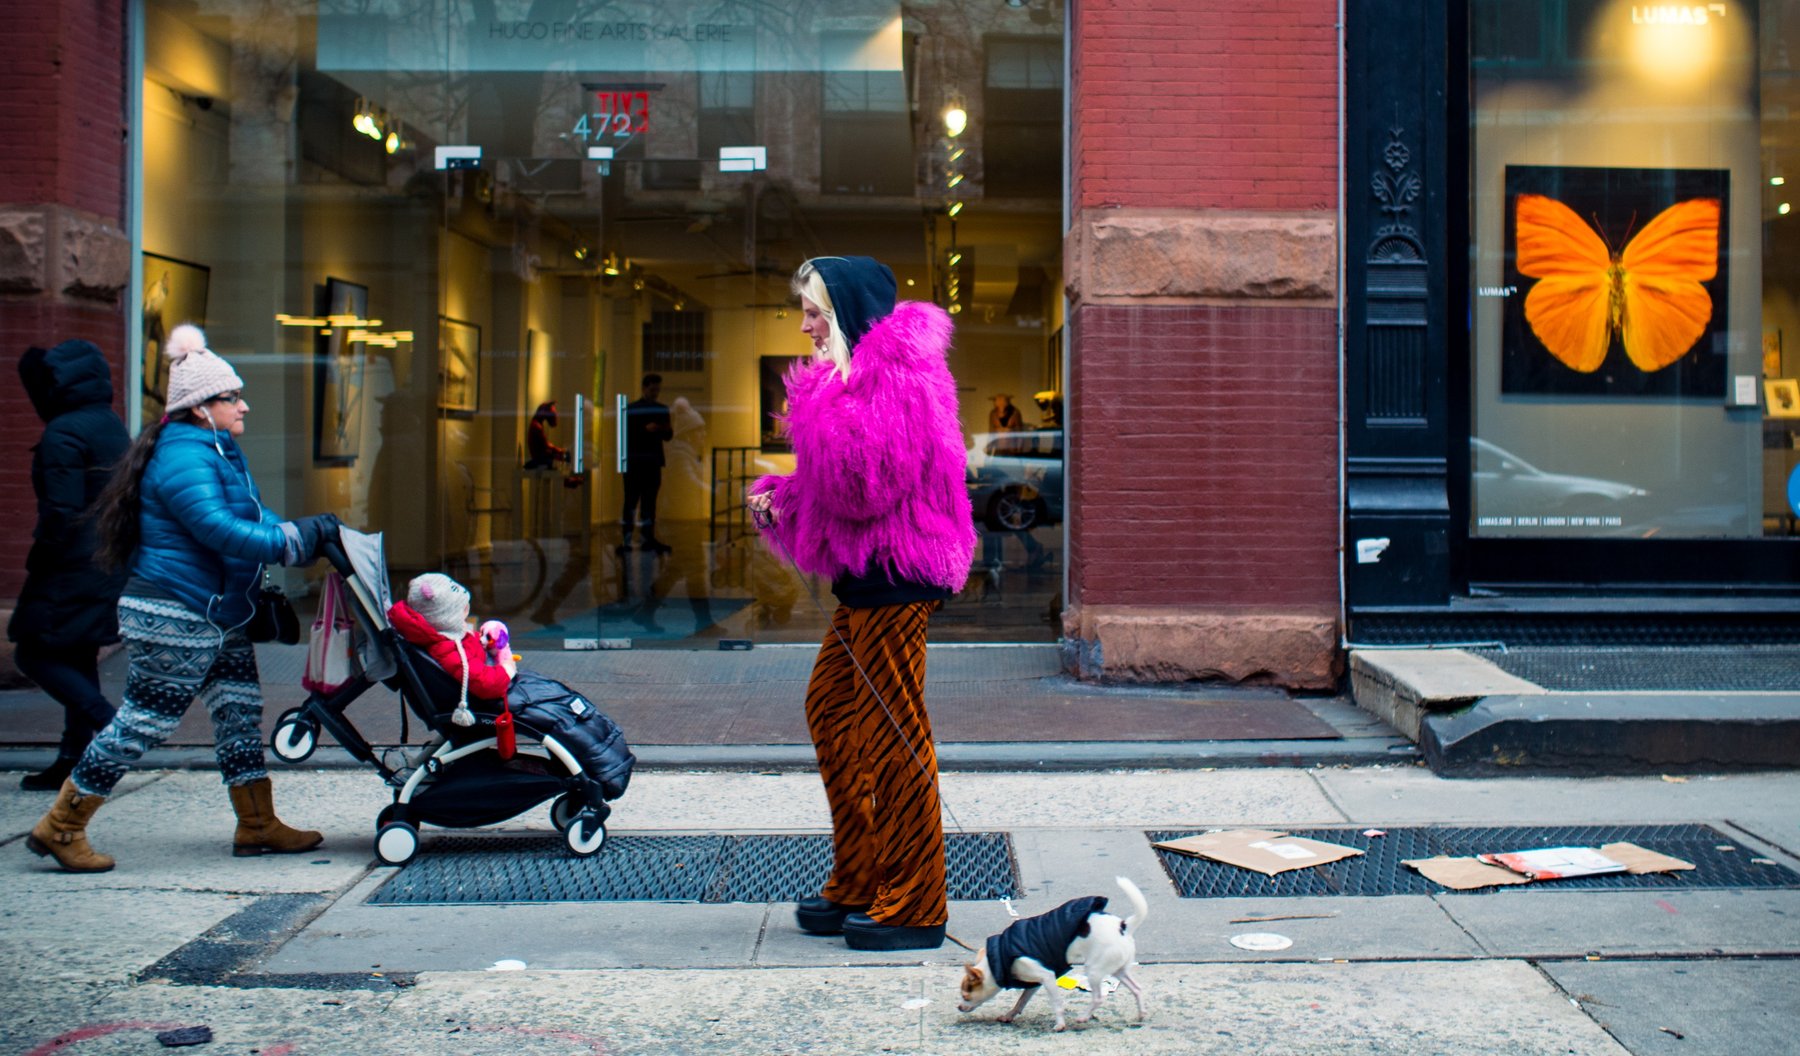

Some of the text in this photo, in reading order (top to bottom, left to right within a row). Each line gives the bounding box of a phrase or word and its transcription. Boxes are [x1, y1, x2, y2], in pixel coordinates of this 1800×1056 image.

[1632, 5, 1708, 25] LUMAS
[489, 21, 733, 42] HUGO FINE ARTS GALERIE
[572, 112, 631, 141] 472
[1479, 286, 1510, 297] LUMAS
[1570, 516, 1584, 526] NEW
[1586, 516, 1600, 526] YORK
[1605, 516, 1622, 526] PARIS
